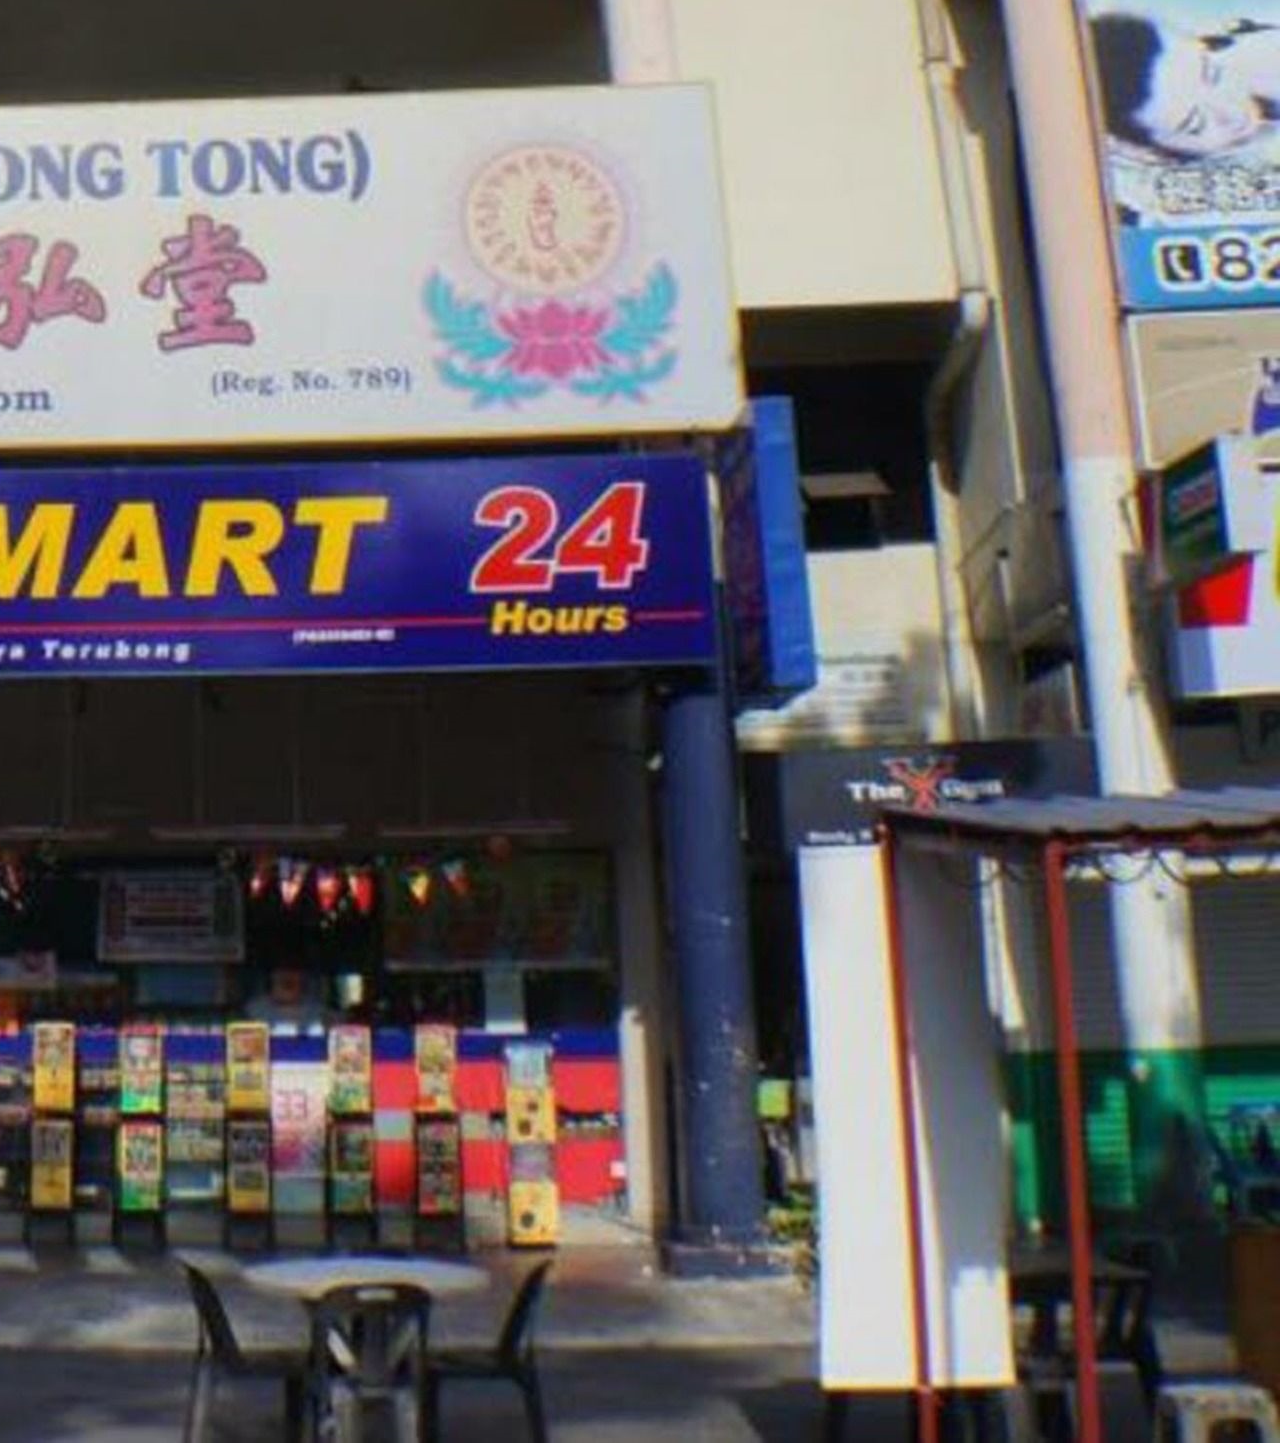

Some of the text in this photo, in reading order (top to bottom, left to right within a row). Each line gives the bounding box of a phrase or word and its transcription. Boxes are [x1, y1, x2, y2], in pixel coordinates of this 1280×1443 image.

[145, 131, 372, 202] TONG)
[211, 364, 412, 397] (Reg. No. 789)
[470, 480, 649, 592] 24
[491, 600, 628, 635] Hours
[845, 781, 906, 802] The
